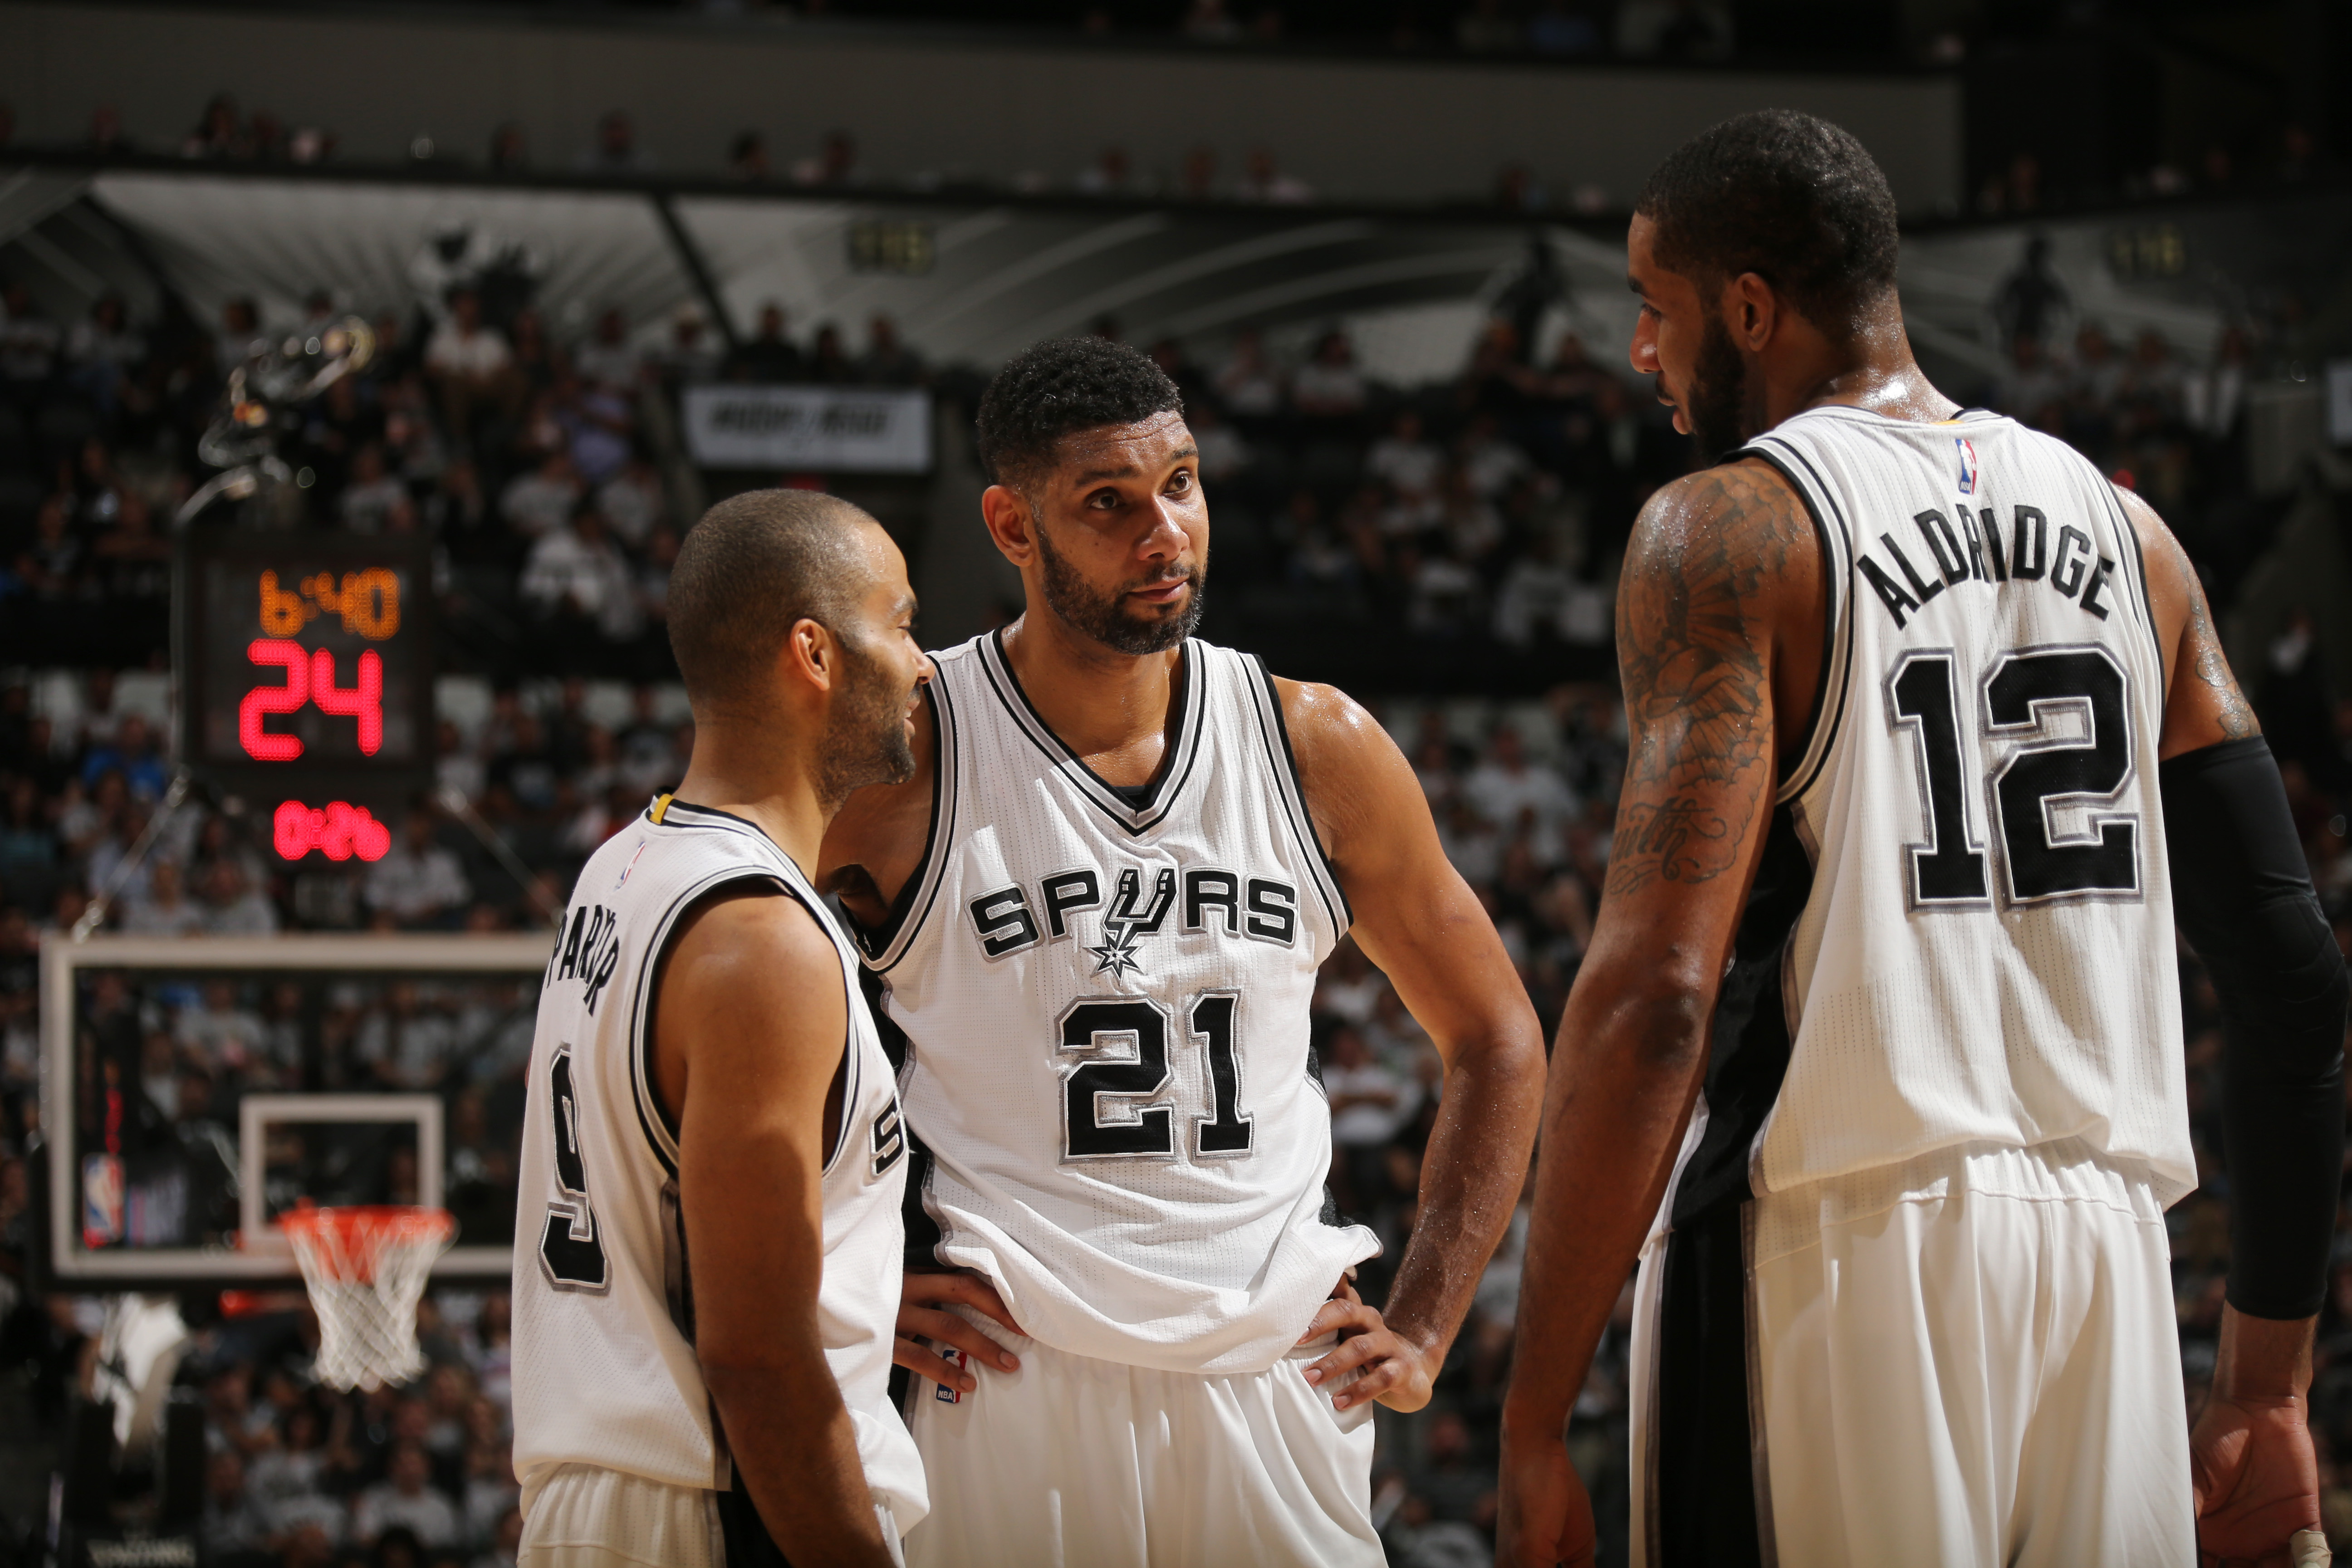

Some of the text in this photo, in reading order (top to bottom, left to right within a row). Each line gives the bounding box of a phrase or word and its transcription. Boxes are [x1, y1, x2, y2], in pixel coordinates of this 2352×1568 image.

[1960, 481, 1971, 491] NBA
[260, 567, 401, 640] 6:40
[1857, 504, 2115, 630] ALDRIDGE
[239, 638, 382, 761] 24
[1882, 642, 2144, 912] 12
[965, 865, 1300, 964] SPURS
[1054, 988, 1255, 1164] 21
[538, 1041, 610, 1294] 9
[937, 1390, 953, 1401] NBA
